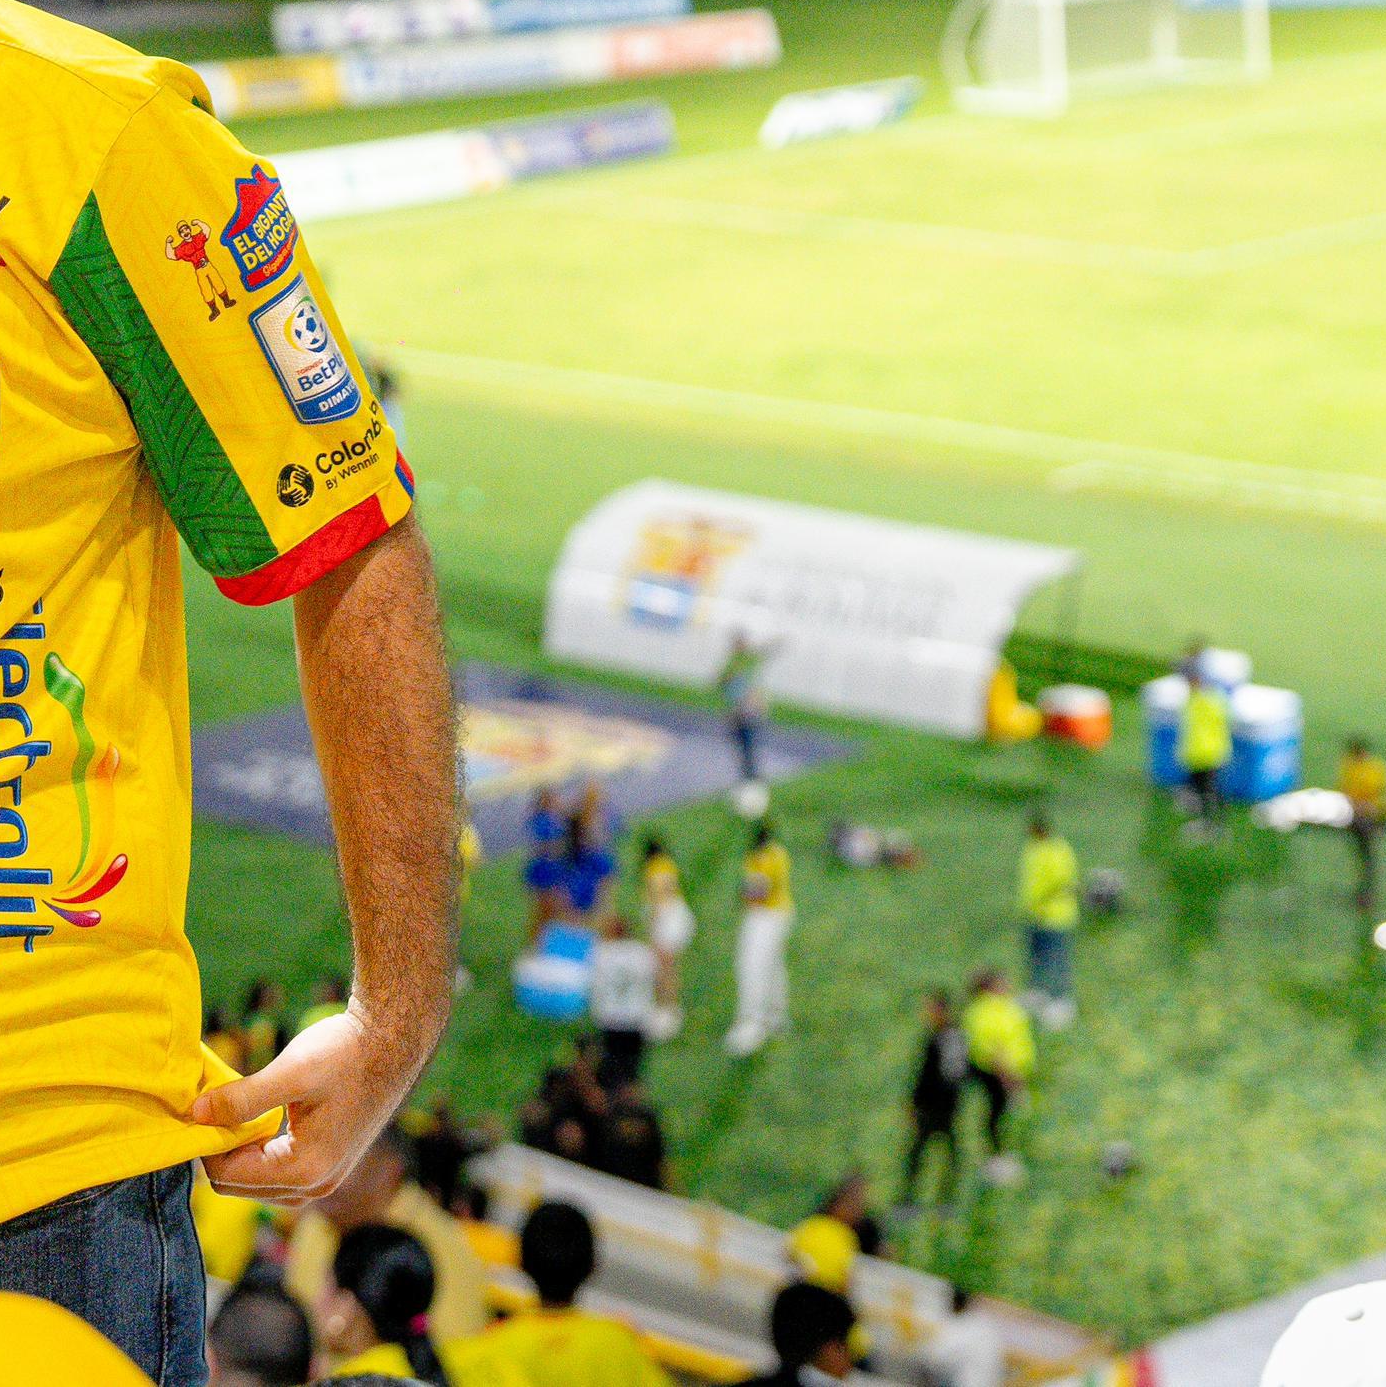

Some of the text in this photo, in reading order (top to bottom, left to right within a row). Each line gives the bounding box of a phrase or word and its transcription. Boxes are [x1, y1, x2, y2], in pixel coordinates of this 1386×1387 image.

[233, 233, 256, 254] EL
[253, 190, 286, 239] GIGANT
[242, 243, 273, 270] DEL
[267, 211, 294, 249] HOGA
[297, 353, 344, 392] BetPl
[325, 477, 338, 491] By
